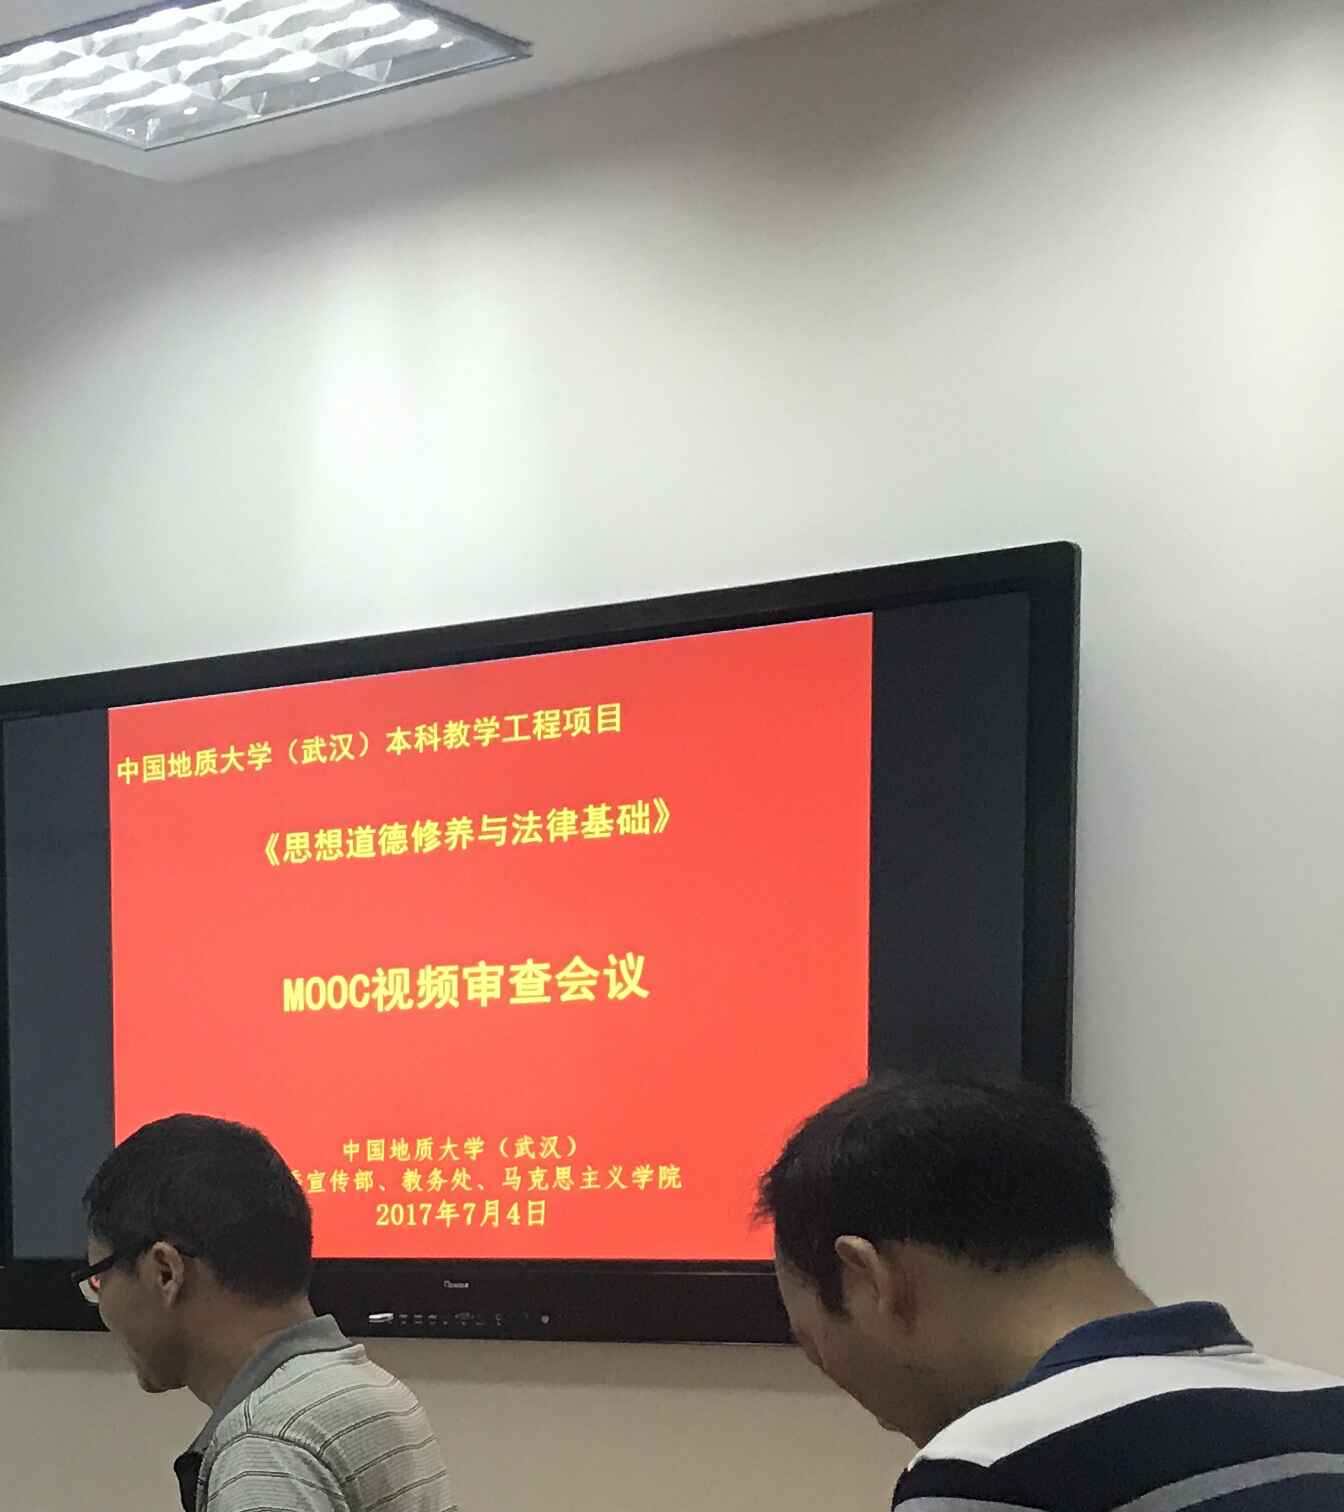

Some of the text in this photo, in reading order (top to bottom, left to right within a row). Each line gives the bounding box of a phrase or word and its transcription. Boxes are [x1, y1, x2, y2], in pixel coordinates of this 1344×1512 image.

[263, 797, 672, 868] 《思想道德修养与法律基础》
[282, 951, 652, 1014] MOOC视频审查会议
[375, 1199, 547, 1228] 2017年7月4日
